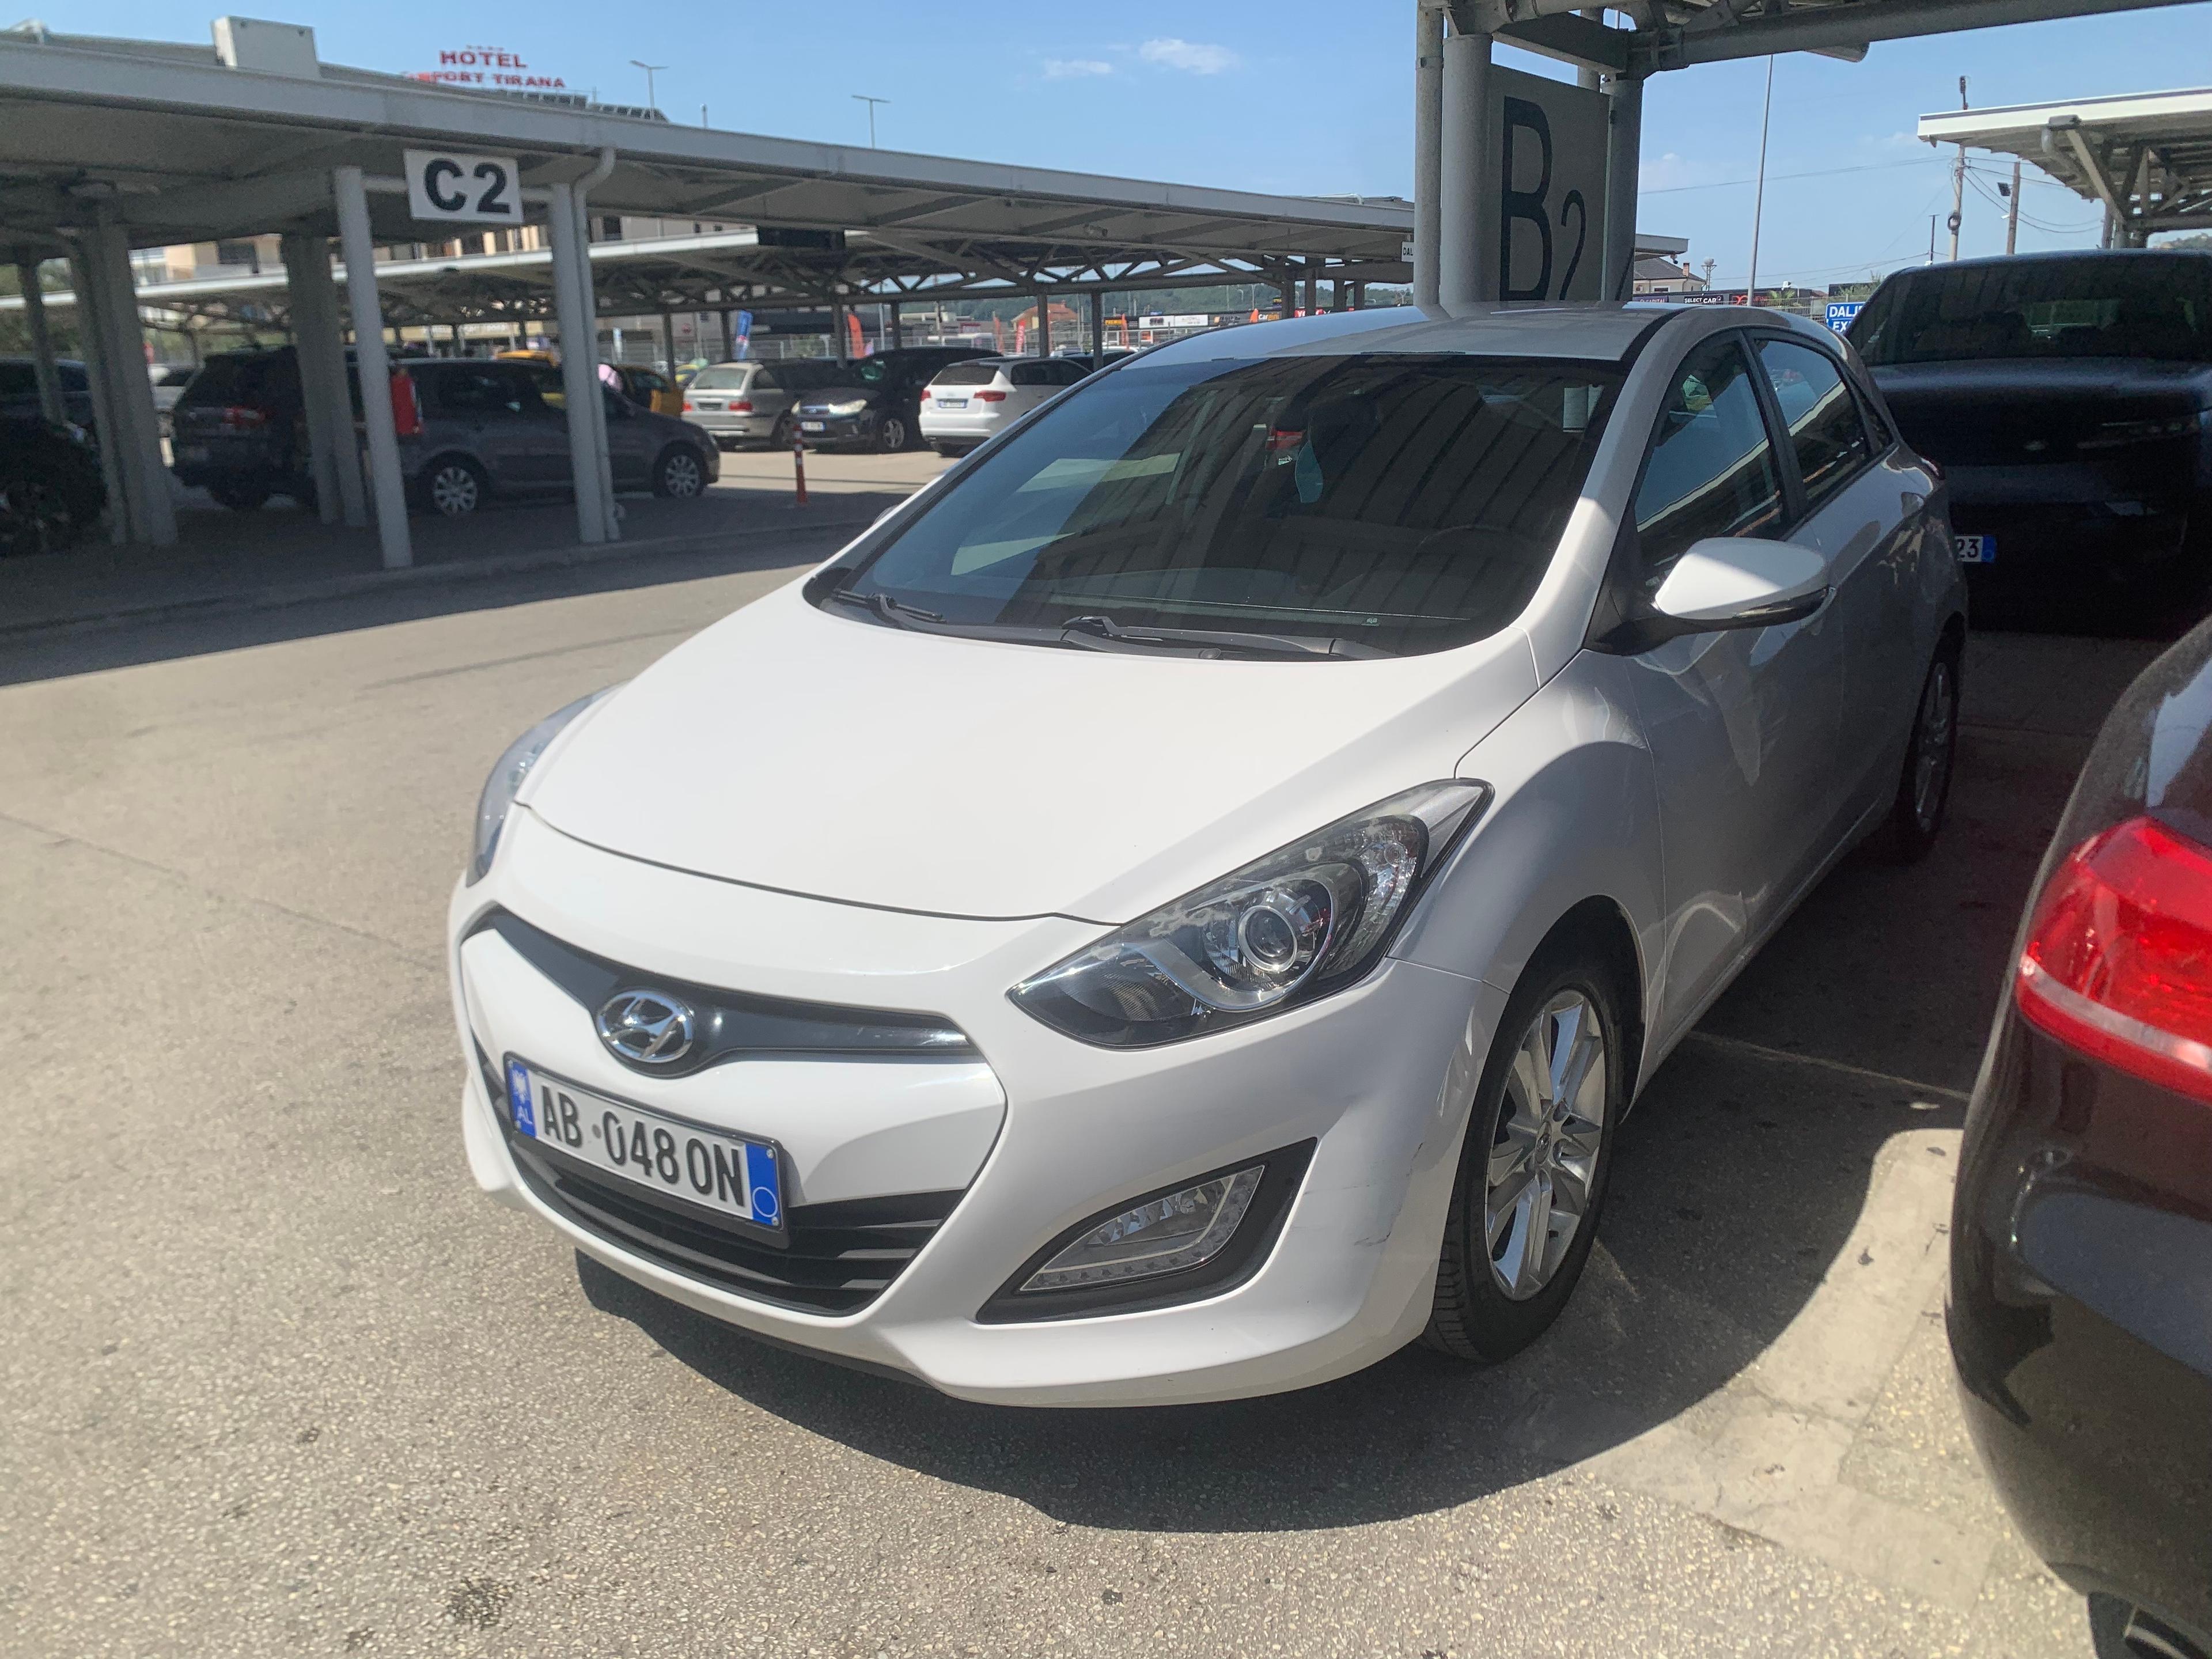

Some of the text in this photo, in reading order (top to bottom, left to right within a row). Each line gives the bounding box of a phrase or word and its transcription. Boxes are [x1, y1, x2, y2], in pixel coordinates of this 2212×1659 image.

[440, 50, 528, 69] HOTEL
[493, 73, 567, 88] TIRANA
[424, 158, 510, 214] C2
[1499, 96, 1586, 301] B2
[1832, 321, 1851, 332] EX
[517, 1105, 533, 1125] AL
[540, 1085, 583, 1149] AB
[602, 1110, 681, 1185] 048
